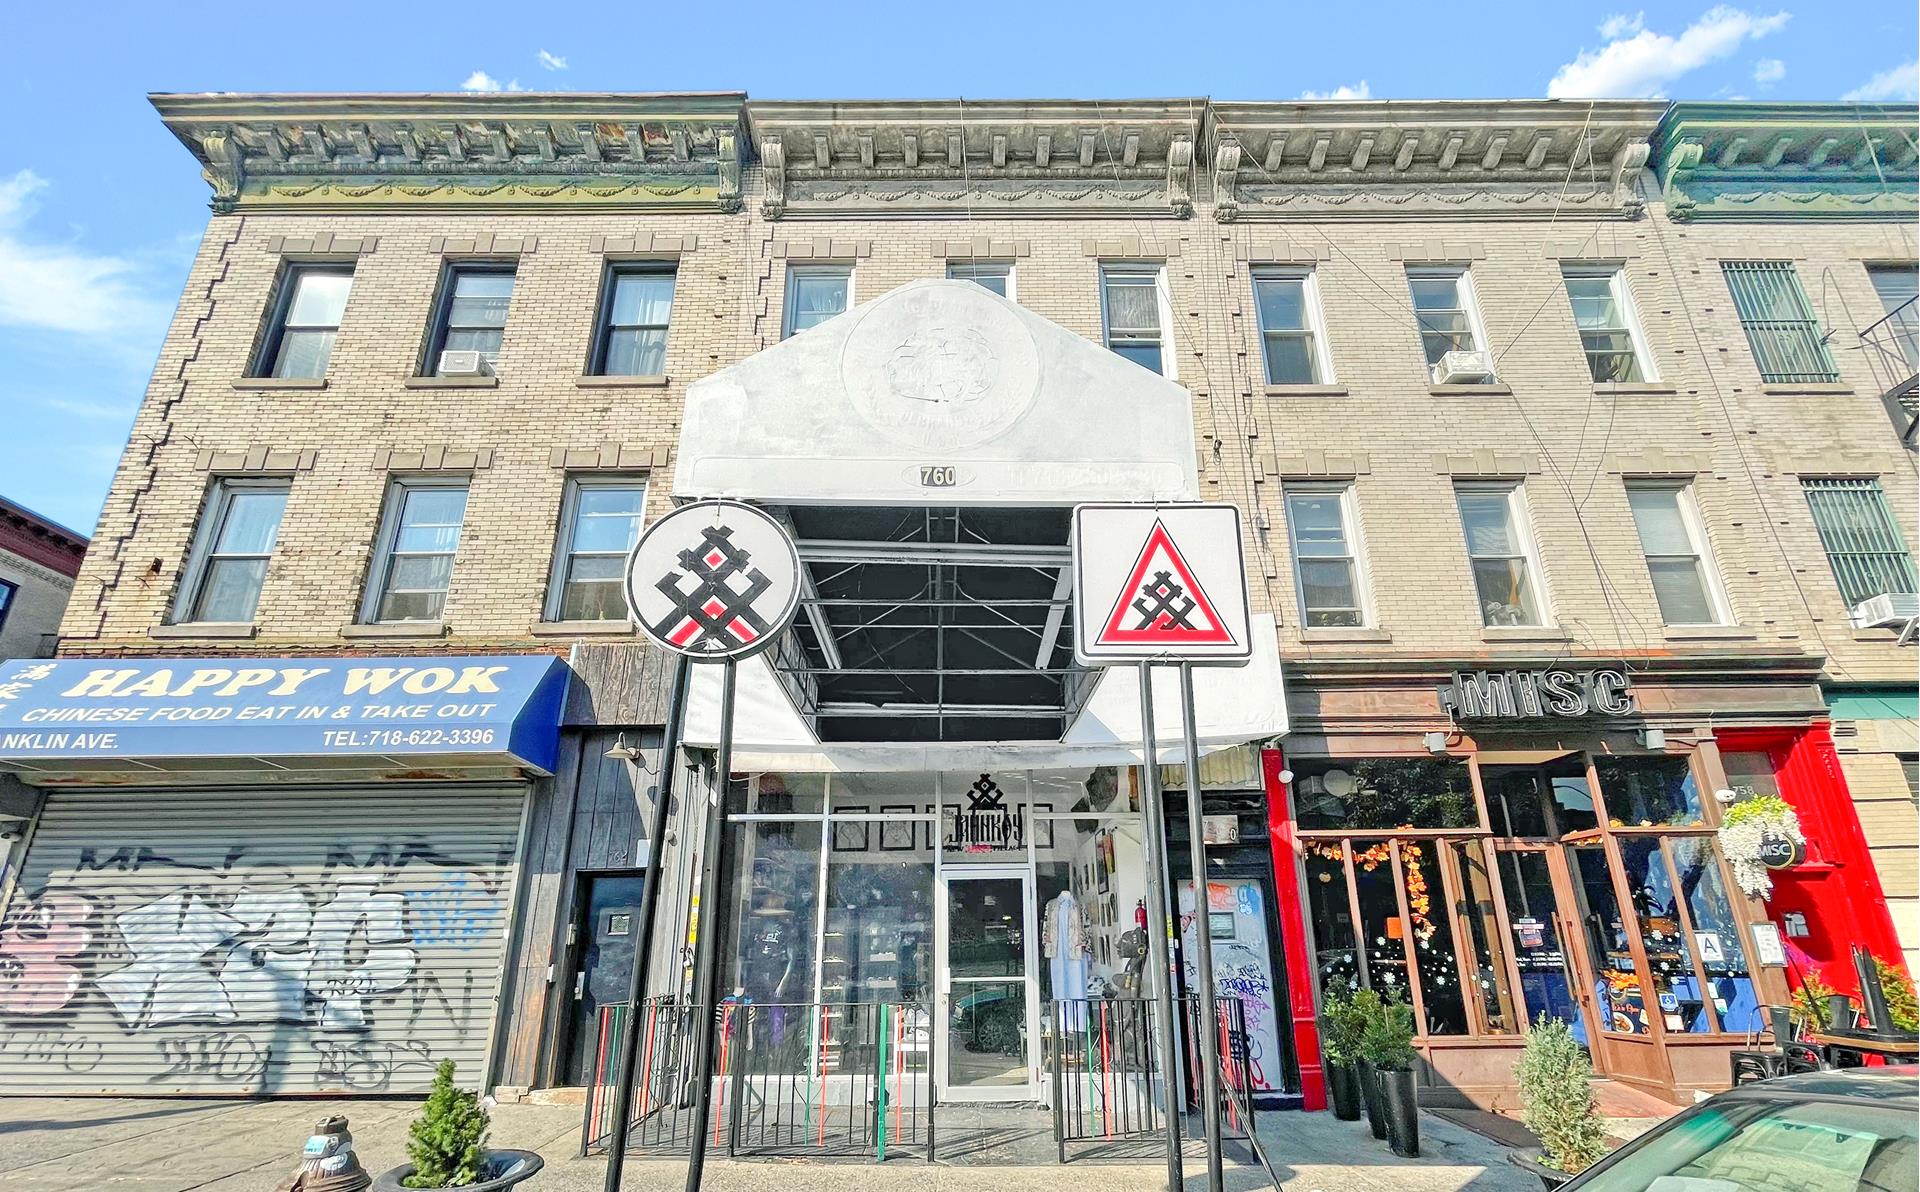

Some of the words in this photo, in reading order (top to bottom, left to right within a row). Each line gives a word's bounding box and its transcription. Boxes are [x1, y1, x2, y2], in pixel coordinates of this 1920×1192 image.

[921, 467, 956, 486] 760
[60, 668, 331, 697] HAPPY
[343, 666, 509, 695] WOK
[1454, 669, 1634, 717] MISC
[22, 707, 149, 722] CHINESE
[149, 706, 233, 721] FOOD
[235, 705, 296, 720] EAT
[296, 705, 328, 719] IN
[330, 705, 352, 719] &
[360, 704, 433, 719] TAKE
[437, 703, 497, 718] OUT
[71, 733, 119, 749] AVE.
[323, 729, 494, 746] TEL:718-622-3396
[1732, 785, 1755, 795] 758
[1760, 843, 1791, 857] MISC
[1703, 937, 1717, 953] A
